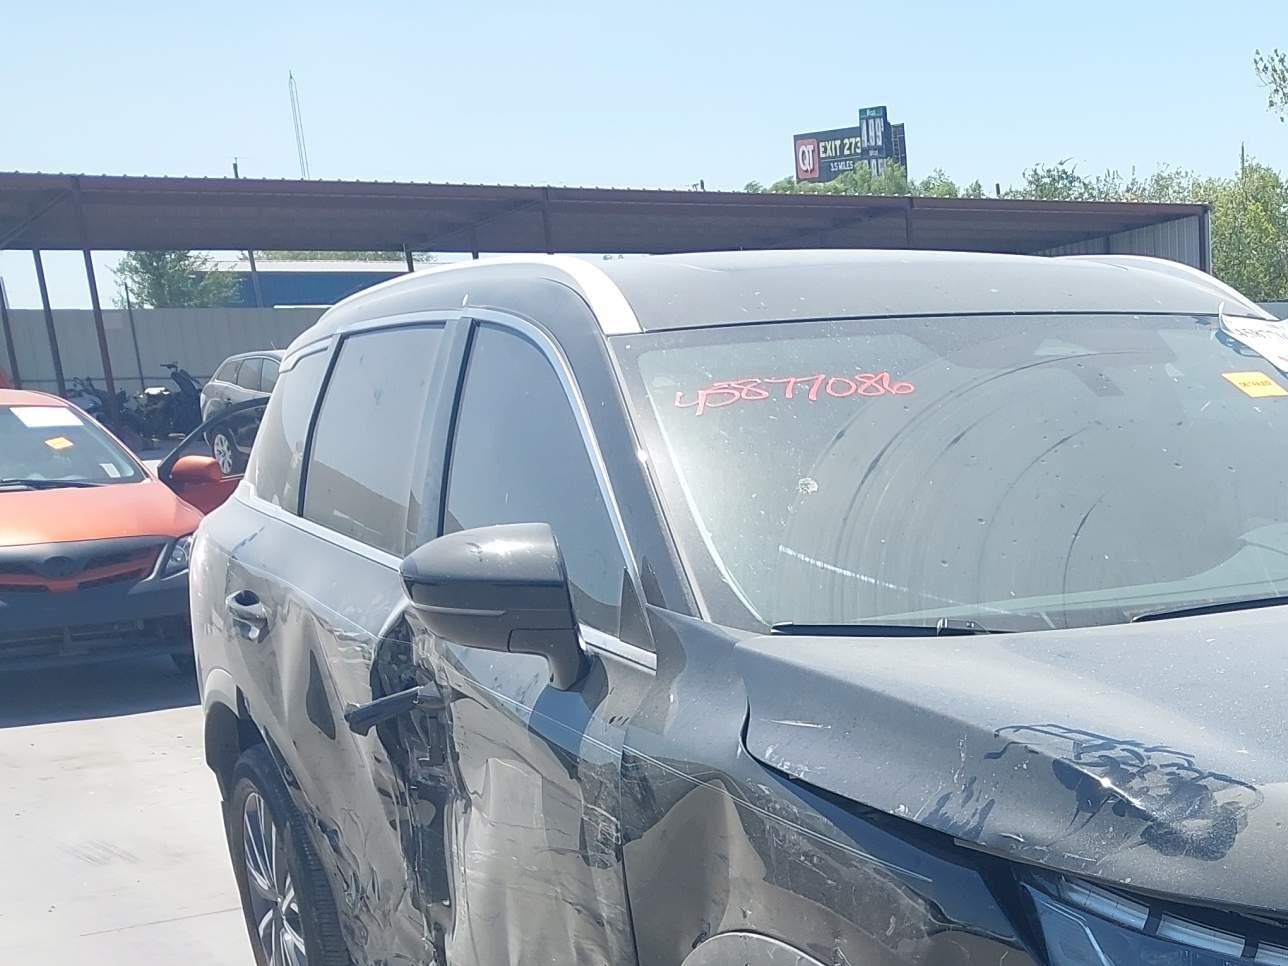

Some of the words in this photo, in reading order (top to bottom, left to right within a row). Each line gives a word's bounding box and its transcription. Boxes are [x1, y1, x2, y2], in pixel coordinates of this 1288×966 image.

[799, 144, 815, 174] QT
[819, 139, 842, 158] EXIT
[843, 137, 861, 155] 273
[839, 160, 854, 170] MILES
[674, 372, 915, 416] 45877086
